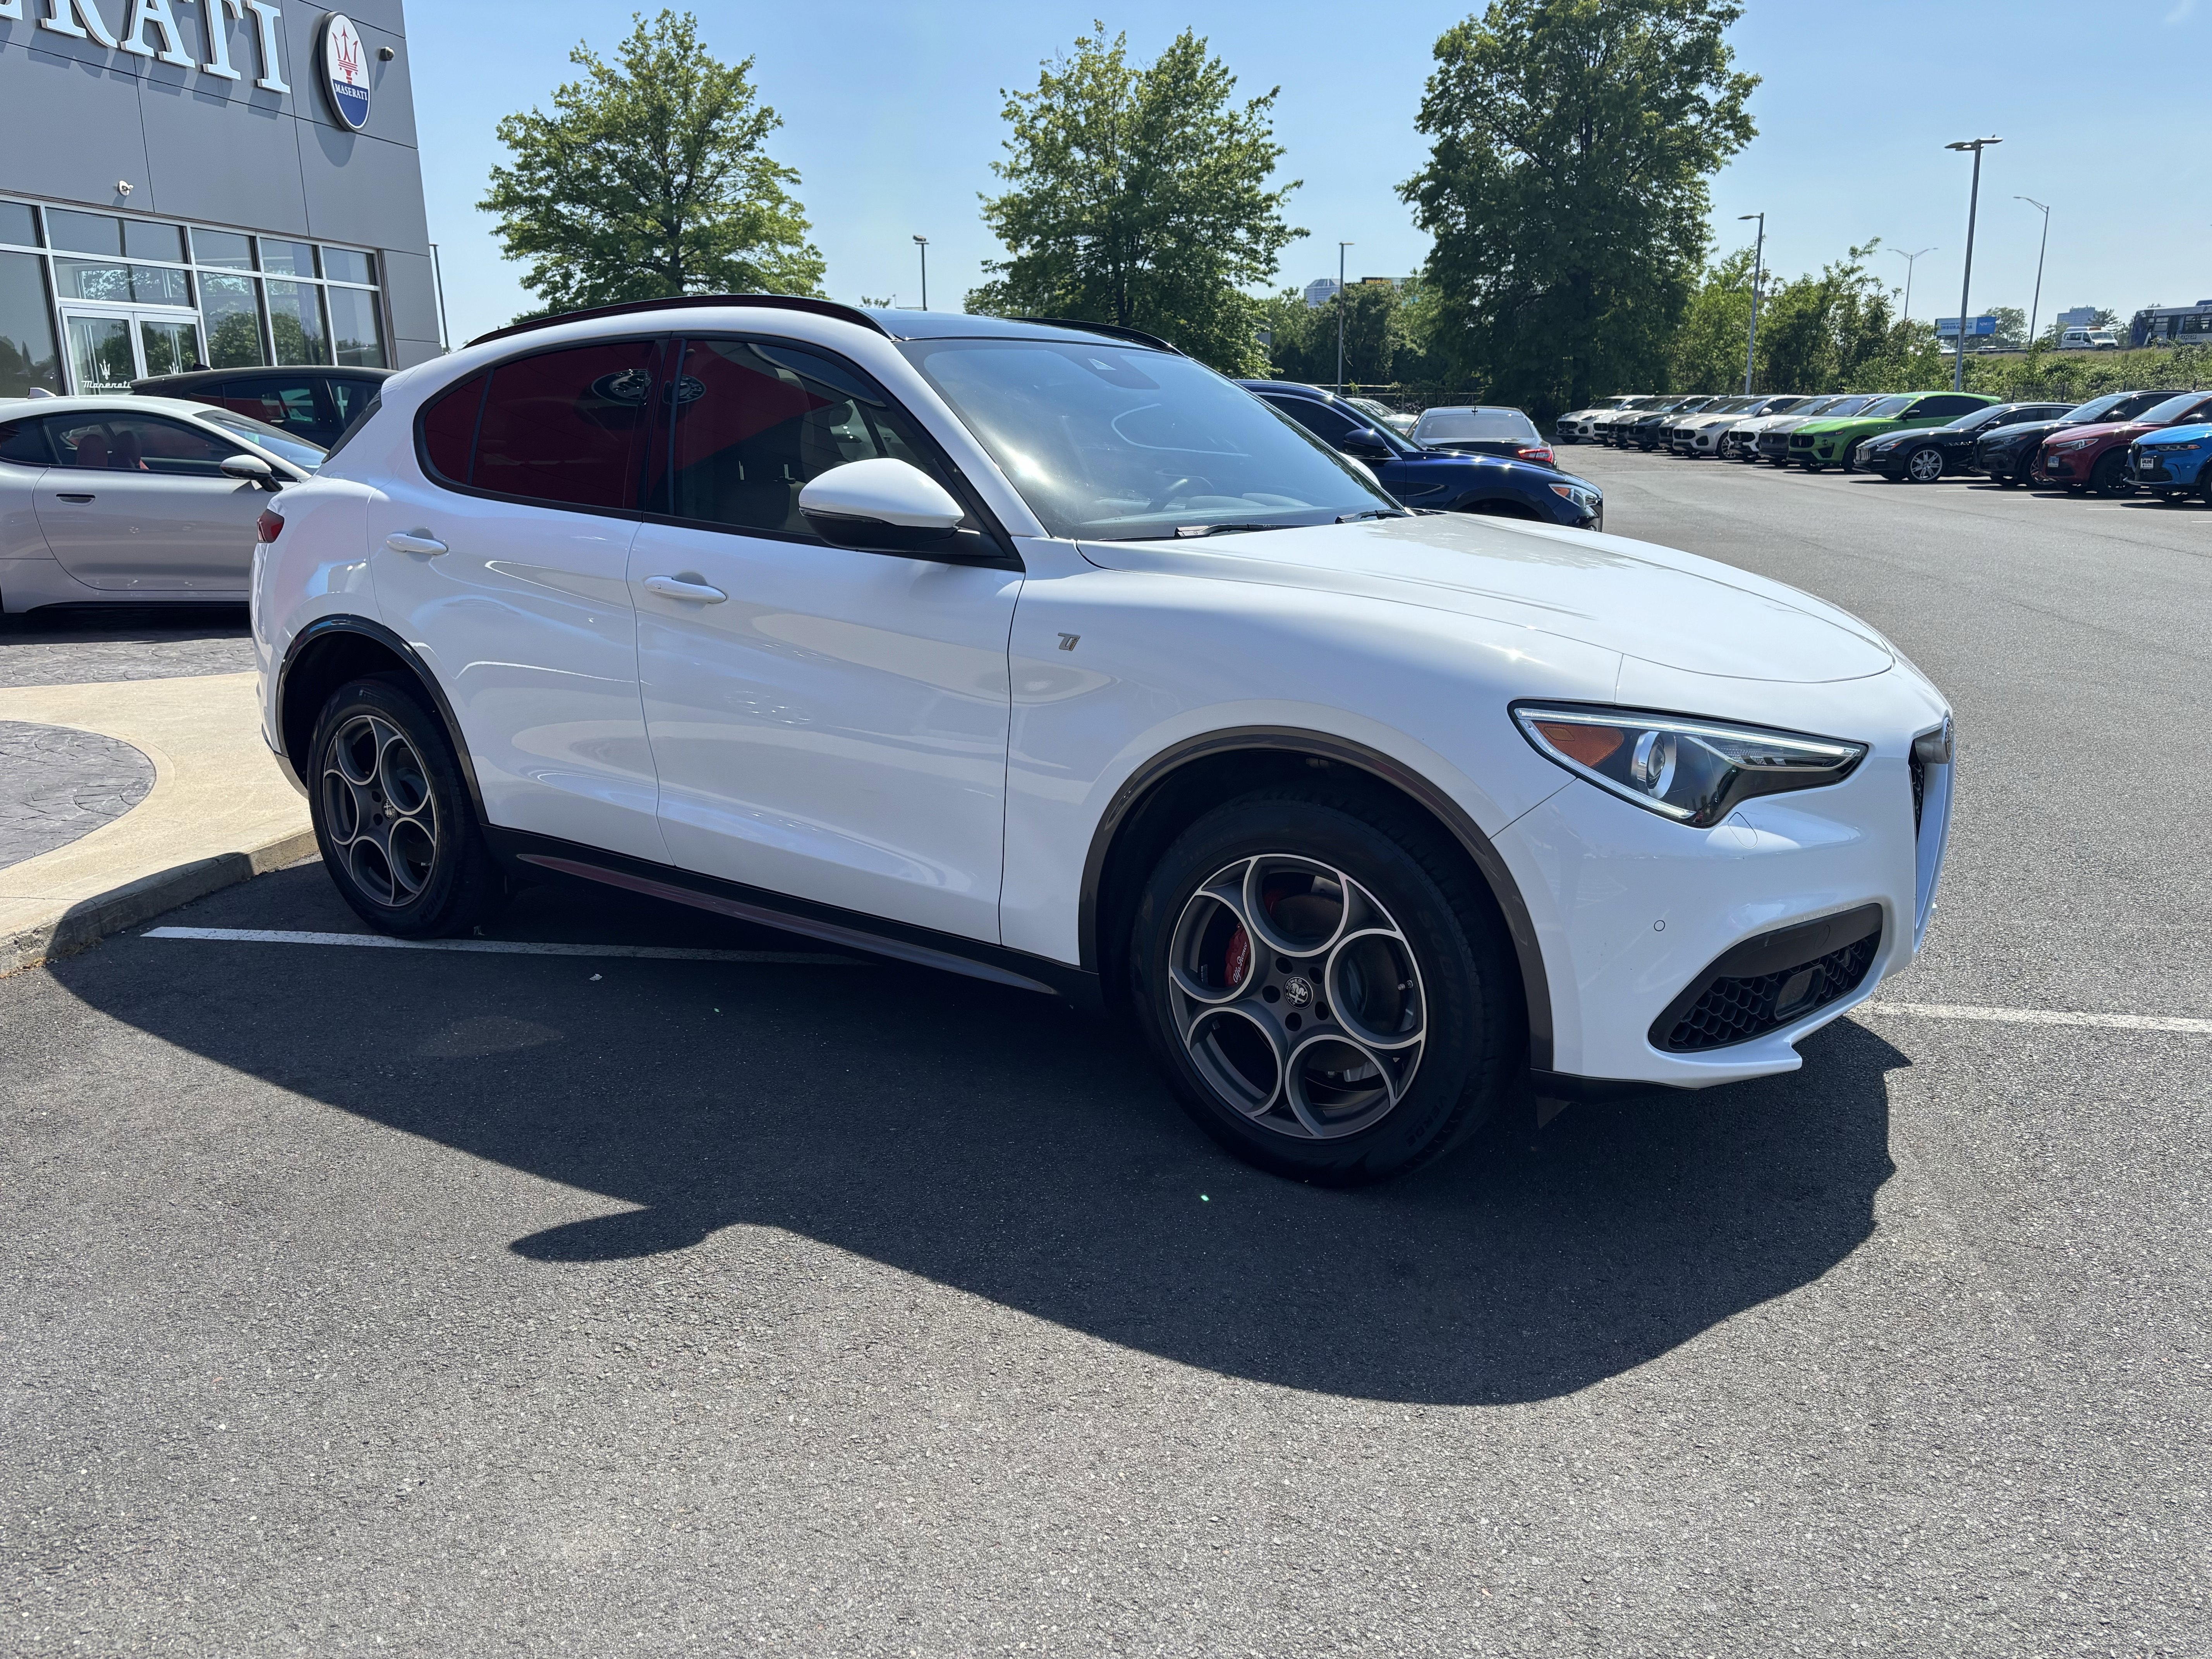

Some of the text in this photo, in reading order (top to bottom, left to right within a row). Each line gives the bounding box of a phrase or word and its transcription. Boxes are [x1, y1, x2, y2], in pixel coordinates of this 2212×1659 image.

[334, 83, 368, 101] MASERATI
[1286, 979, 1302, 1005] ALFA ROMEO
